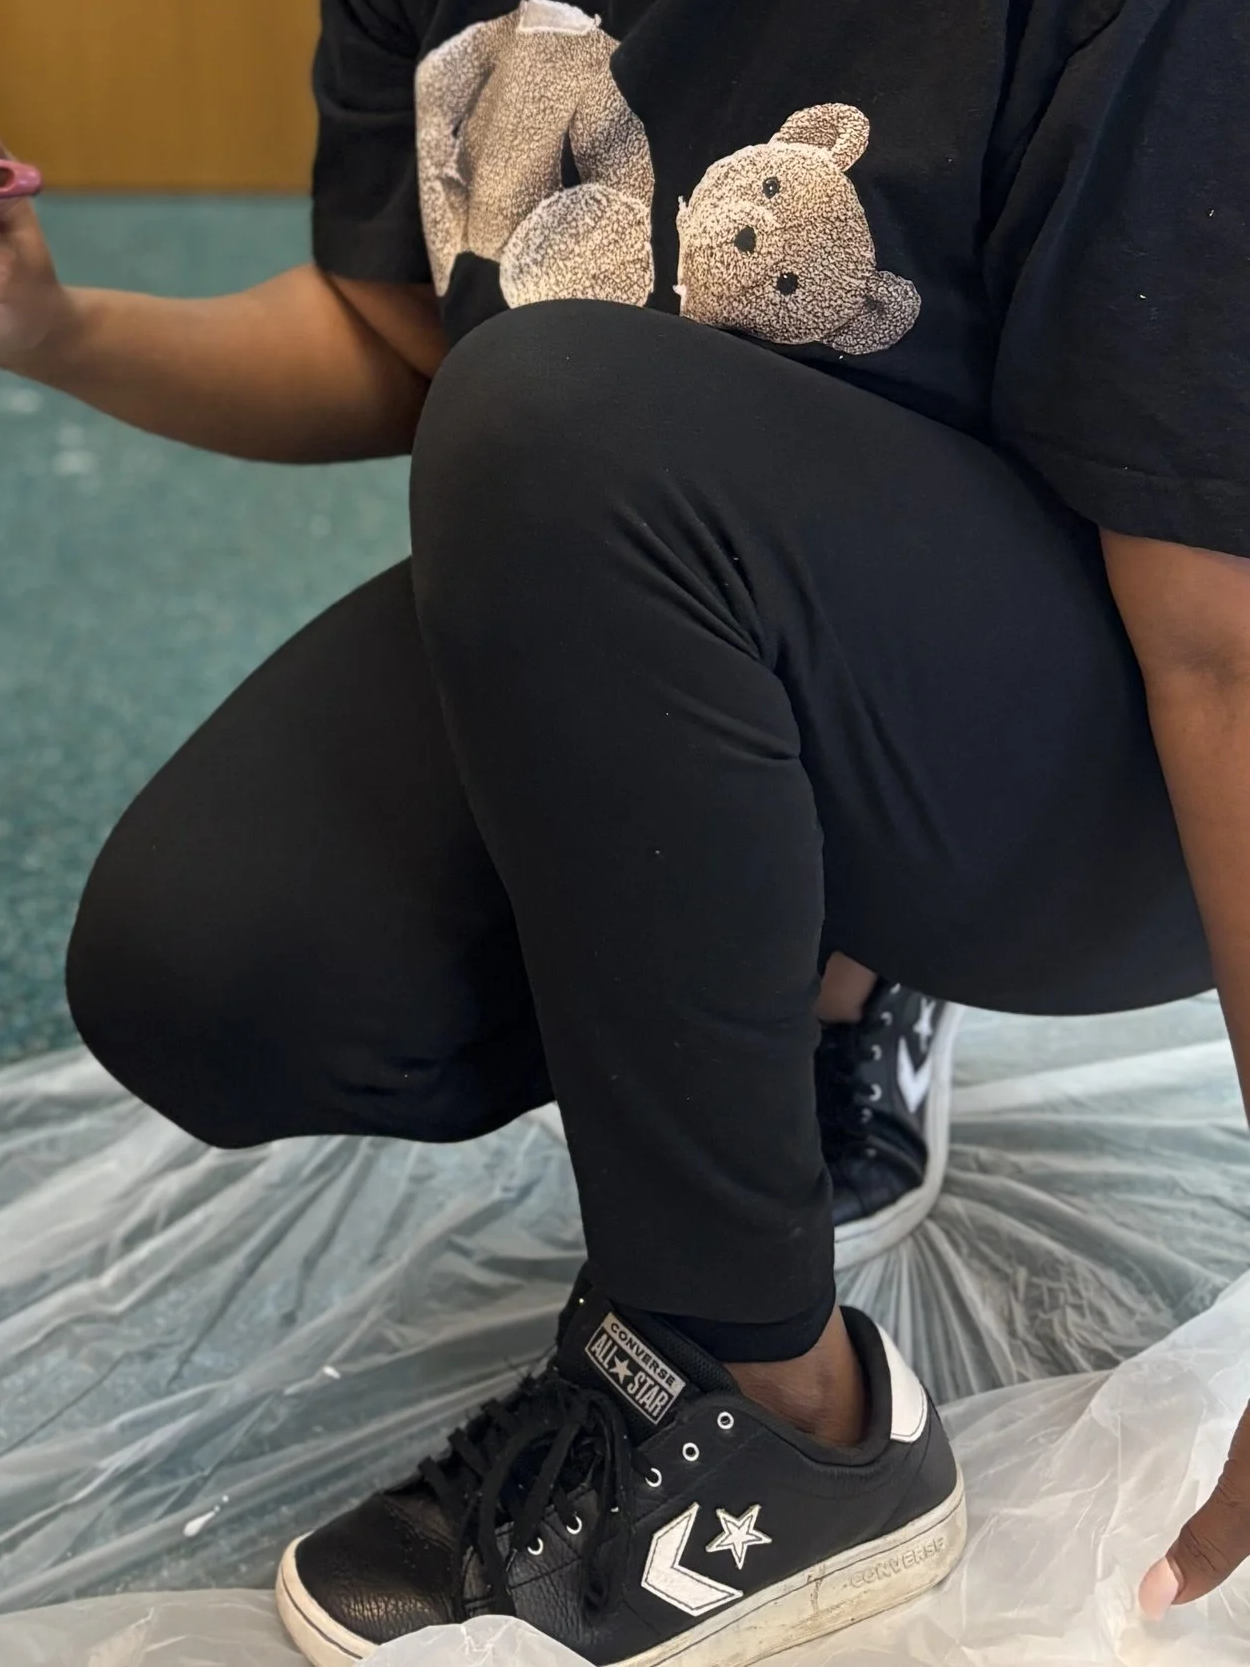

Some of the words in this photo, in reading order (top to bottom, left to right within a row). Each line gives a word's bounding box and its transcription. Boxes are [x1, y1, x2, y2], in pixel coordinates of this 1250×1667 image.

[591, 1334, 618, 1369] ALL
[627, 1371, 669, 1417] STAR
[610, 1323, 676, 1386] CONVERSE
